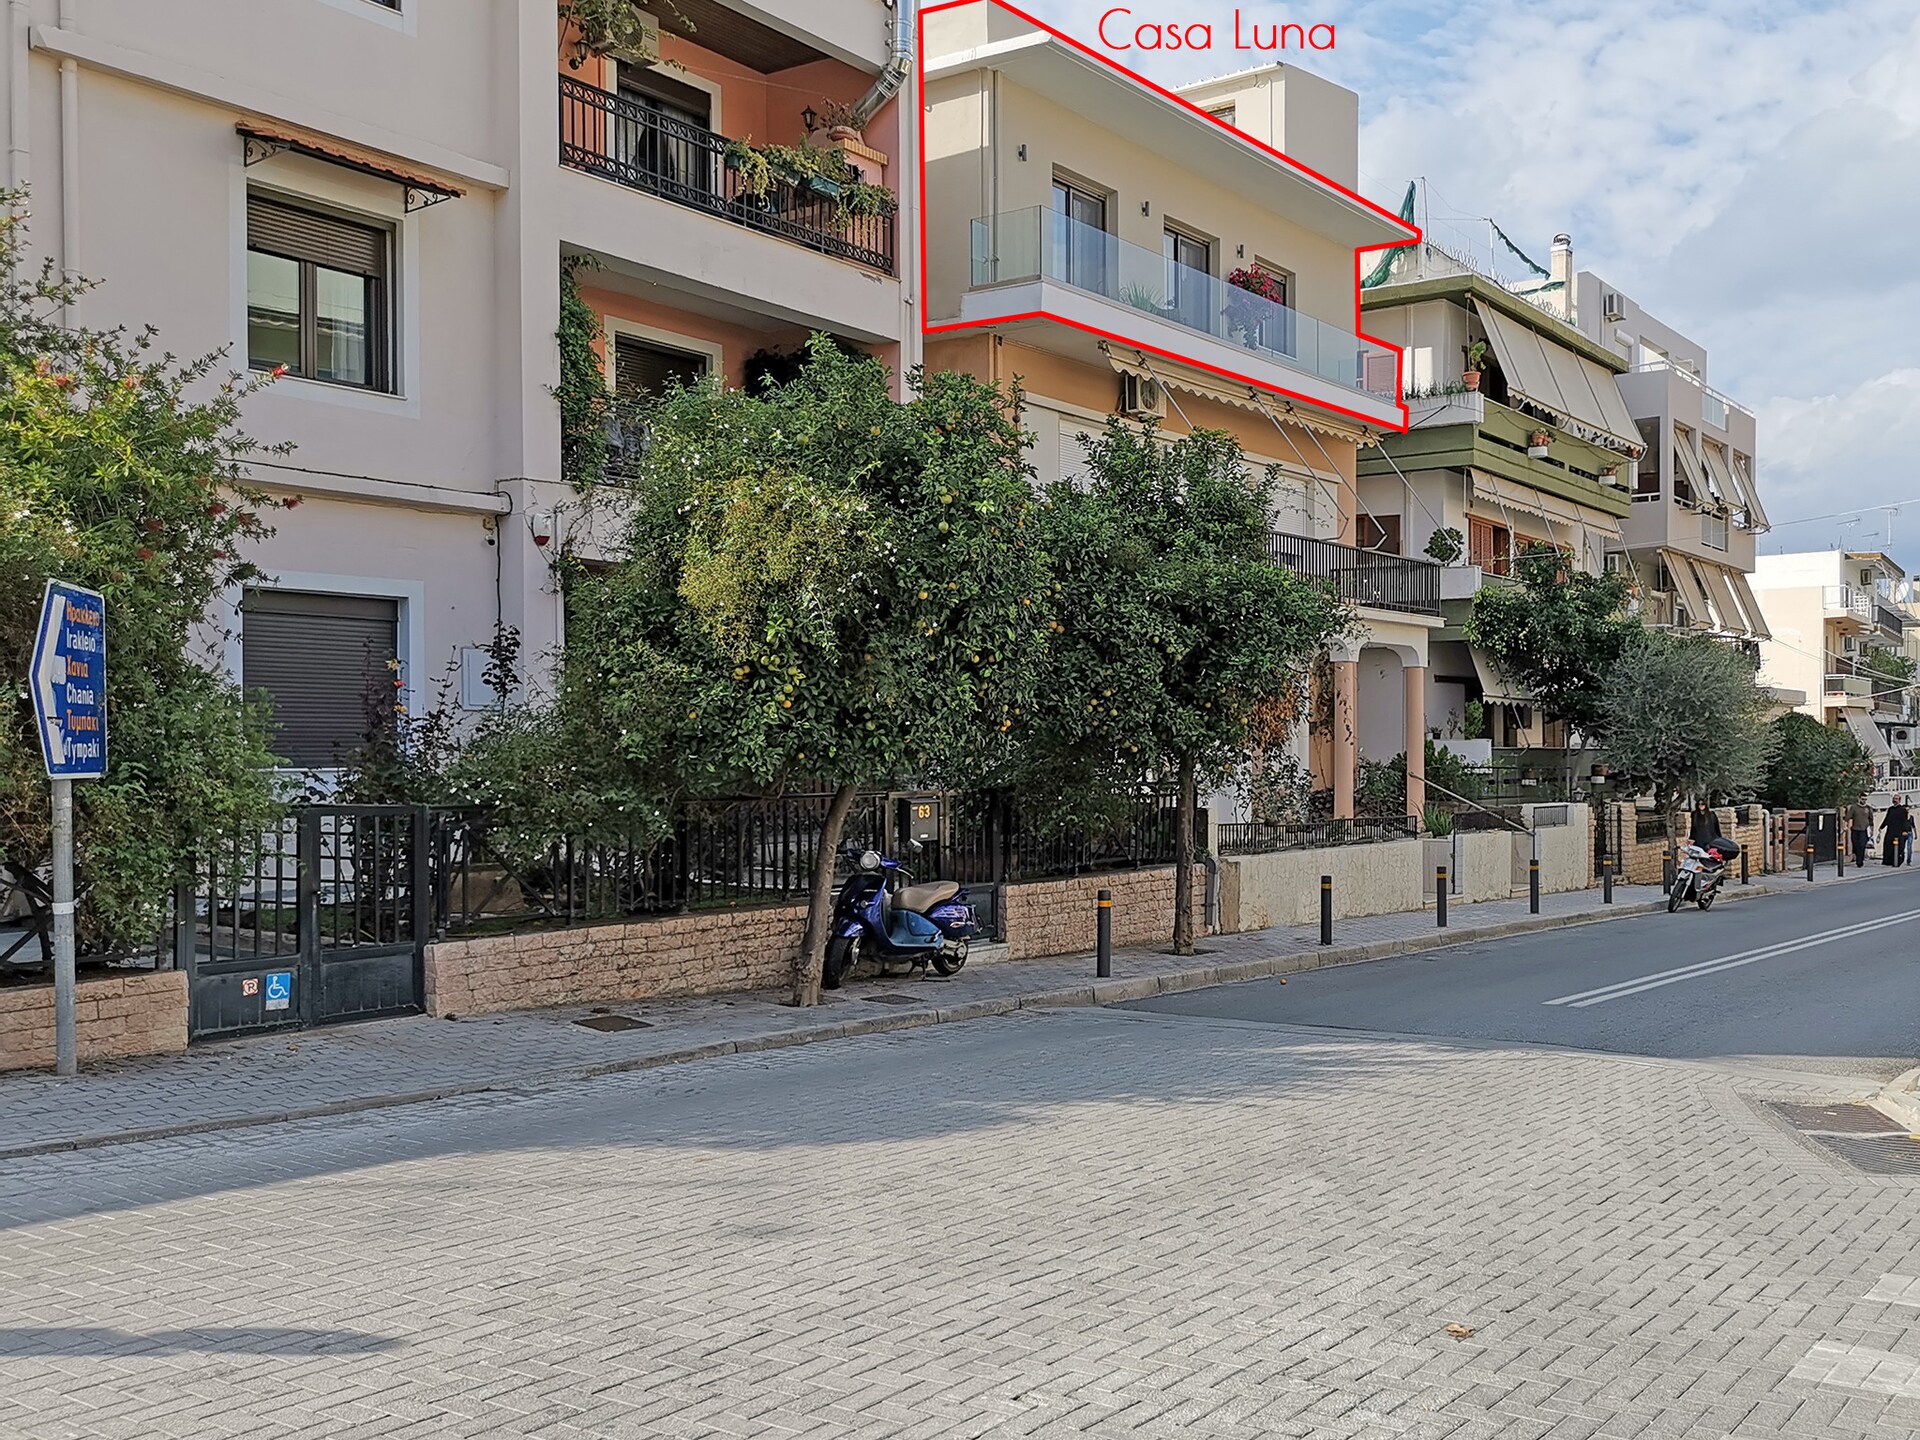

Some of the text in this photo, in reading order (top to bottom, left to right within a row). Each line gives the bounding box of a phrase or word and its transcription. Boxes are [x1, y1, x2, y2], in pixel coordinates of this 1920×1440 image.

[66, 627, 96, 652] Irakleio
[66, 682, 94, 705] Chania
[66, 708, 99, 736] Τυμπάκι
[66, 736, 100, 765] Tympaki
[918, 805, 931, 818] 63
